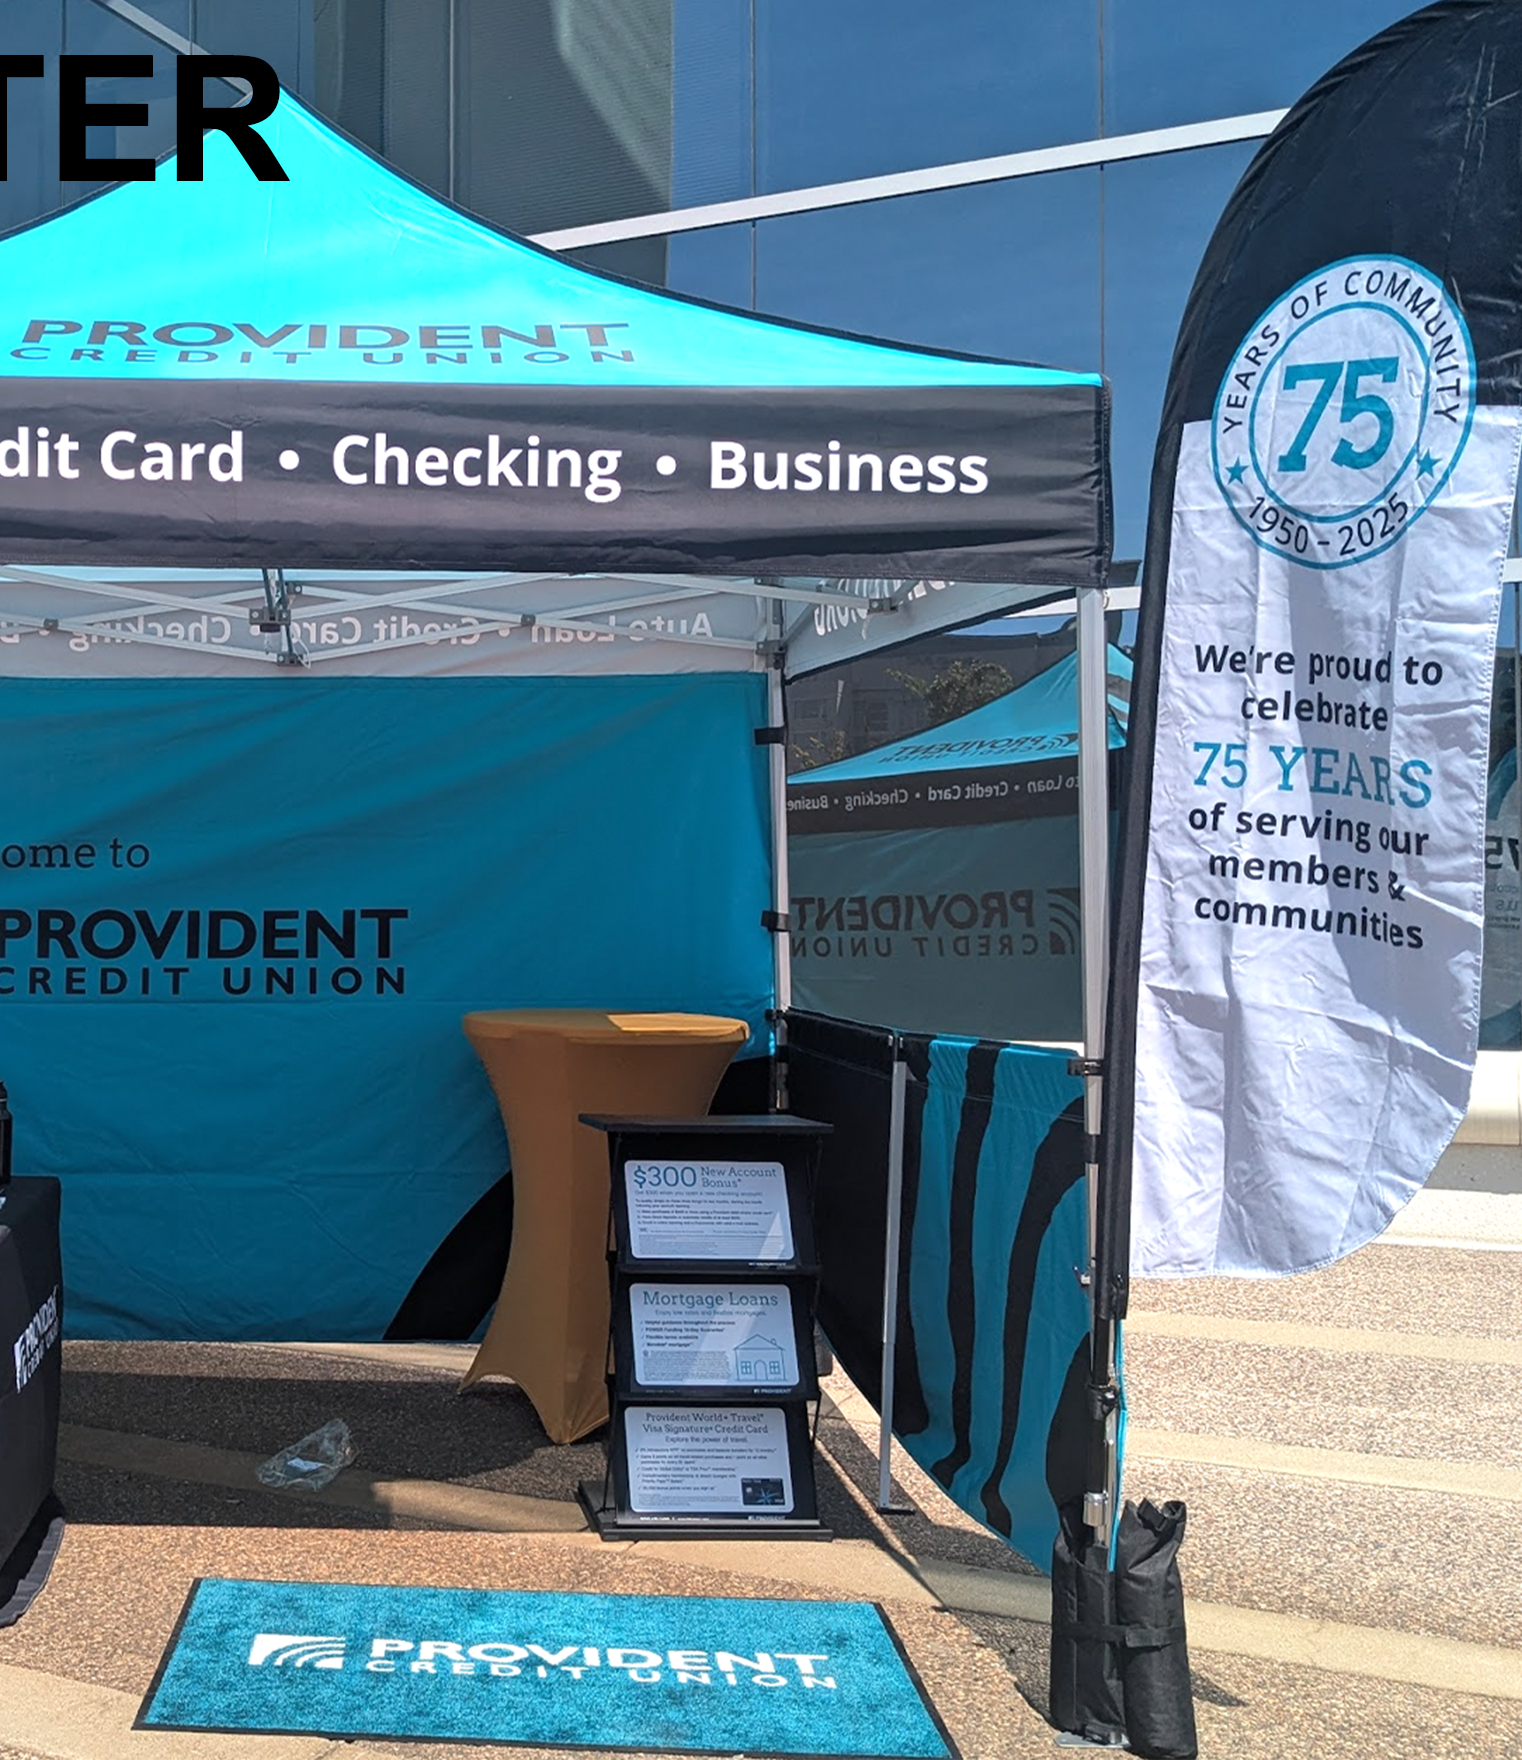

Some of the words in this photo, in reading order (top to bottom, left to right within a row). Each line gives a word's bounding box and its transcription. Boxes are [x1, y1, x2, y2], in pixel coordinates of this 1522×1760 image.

[22, 319, 629, 350] PROVIDENT
[1222, 324, 1280, 434] YEARS
[1291, 280, 1329, 320] OF
[1344, 269, 1461, 424] COMMUNITY
[10, 346, 316, 365] CREDIT
[362, 350, 636, 366] UNION
[1277, 356, 1400, 473] 75
[99, 430, 244, 482] Card
[331, 432, 622, 503] Checking
[709, 438, 989, 494] Business
[1249, 496, 1307, 553] 1950
[1337, 492, 1408, 556] 2025
[1194, 644, 1296, 675] We're
[1308, 651, 1393, 684] proud
[1403, 656, 1444, 686] to
[1241, 690, 1389, 732] celebrate
[1192, 742, 1249, 789] 75
[1268, 744, 1433, 810] YEARS
[1187, 802, 1227, 832] of
[1235, 809, 1371, 855] serving
[1379, 825, 1430, 857] our
[108, 838, 151, 869] to
[1208, 852, 1380, 896] members
[1387, 869, 1406, 902] &
[1194, 896, 1424, 949] communities
[221, 965, 407, 996] UNION
[633, 1165, 697, 1189] $300
[700, 1166, 726, 1176] New
[728, 1167, 777, 1178] Account
[642, 1290, 724, 1309] Mortgage
[728, 1291, 779, 1306] Loans
[642, 1423, 663, 1433] Visa
[714, 1424, 744, 1433] Credit
[744, 1424, 769, 1434] Card
[645, 1412, 691, 1422] Provident
[665, 1435, 689, 1443] Explore
[701, 1436, 721, 1444] power
[365, 1659, 585, 1681] CREDIT
[631, 1669, 837, 1690] UNION
[368, 1637, 830, 1676] PROVIDENT
